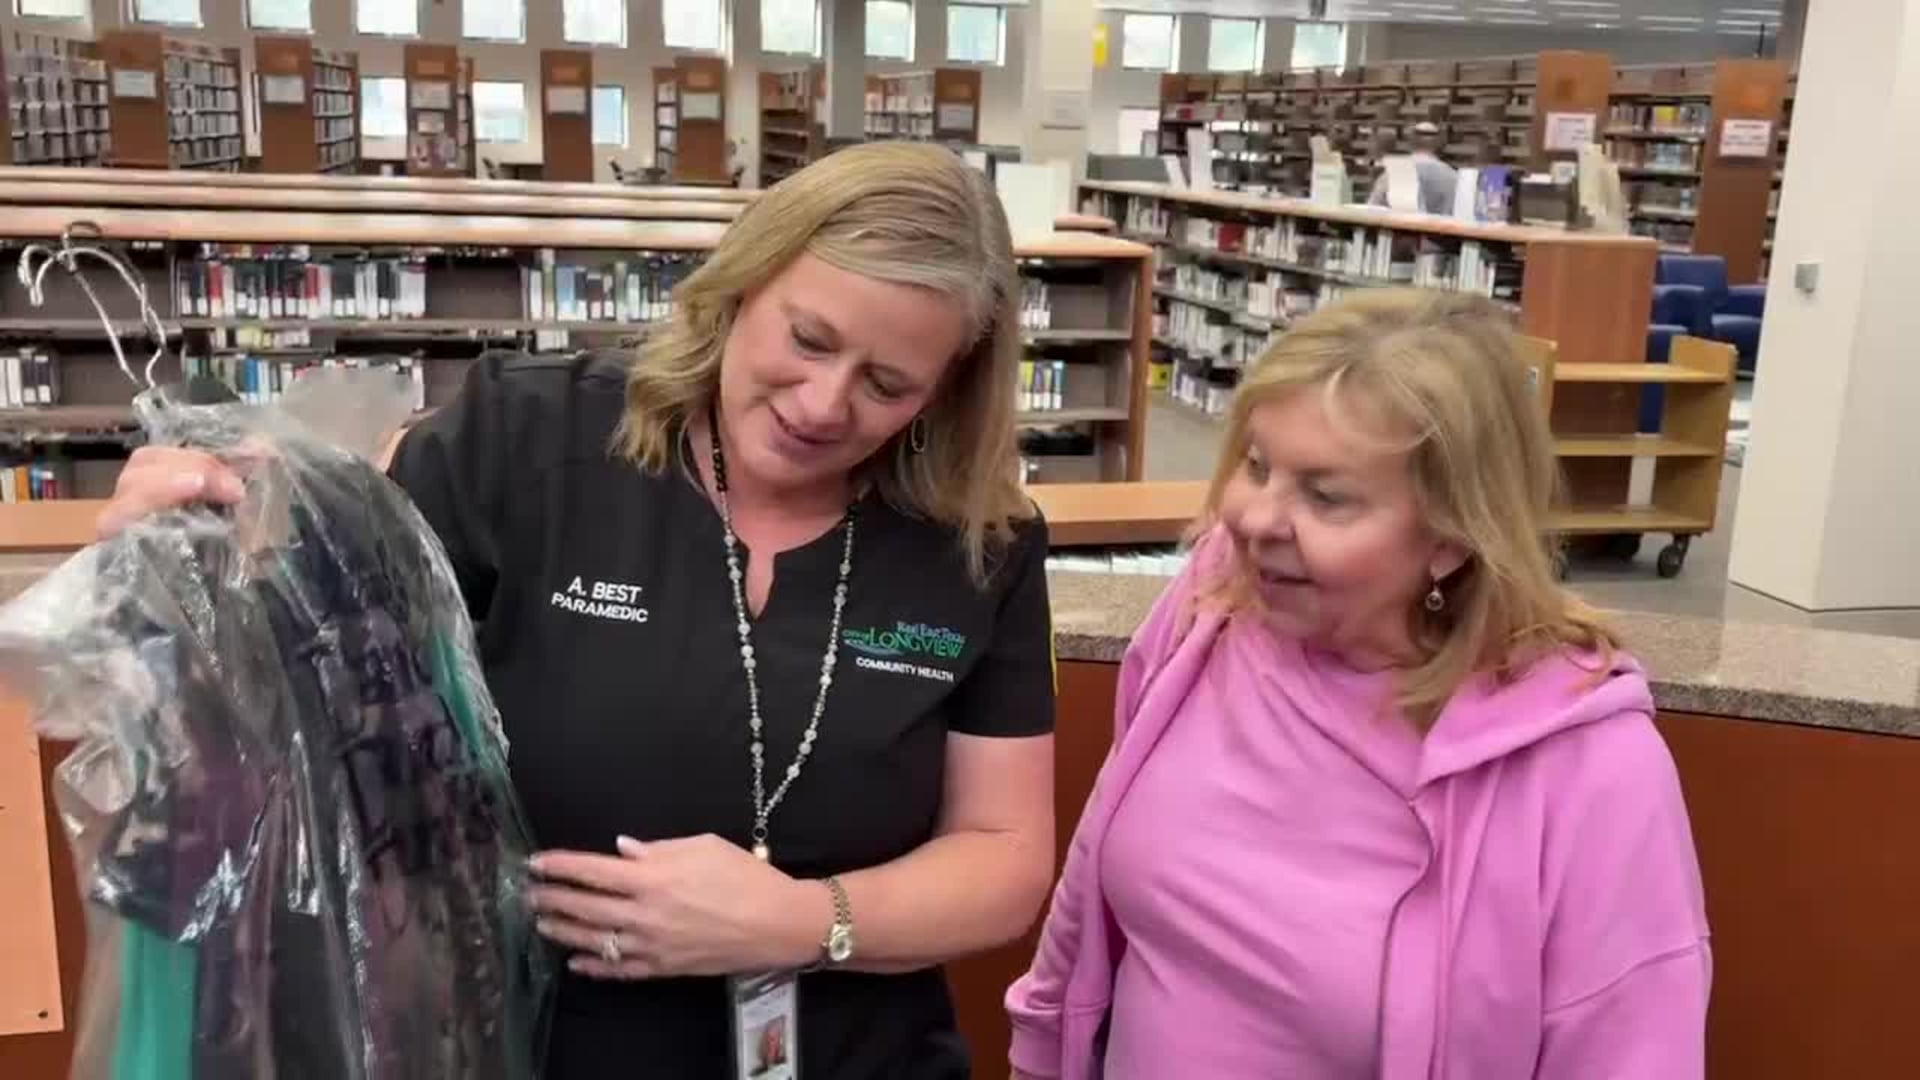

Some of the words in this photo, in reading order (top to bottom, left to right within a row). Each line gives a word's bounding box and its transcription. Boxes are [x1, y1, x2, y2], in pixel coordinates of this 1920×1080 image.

[567, 575, 587, 596] A.
[592, 581, 642, 603] BEST
[551, 592, 648, 622] PARAMEDIC
[870, 627, 963, 658] LONGVIEW
[855, 657, 916, 675] COMMUNITY
[917, 666, 954, 682] HEALTH
